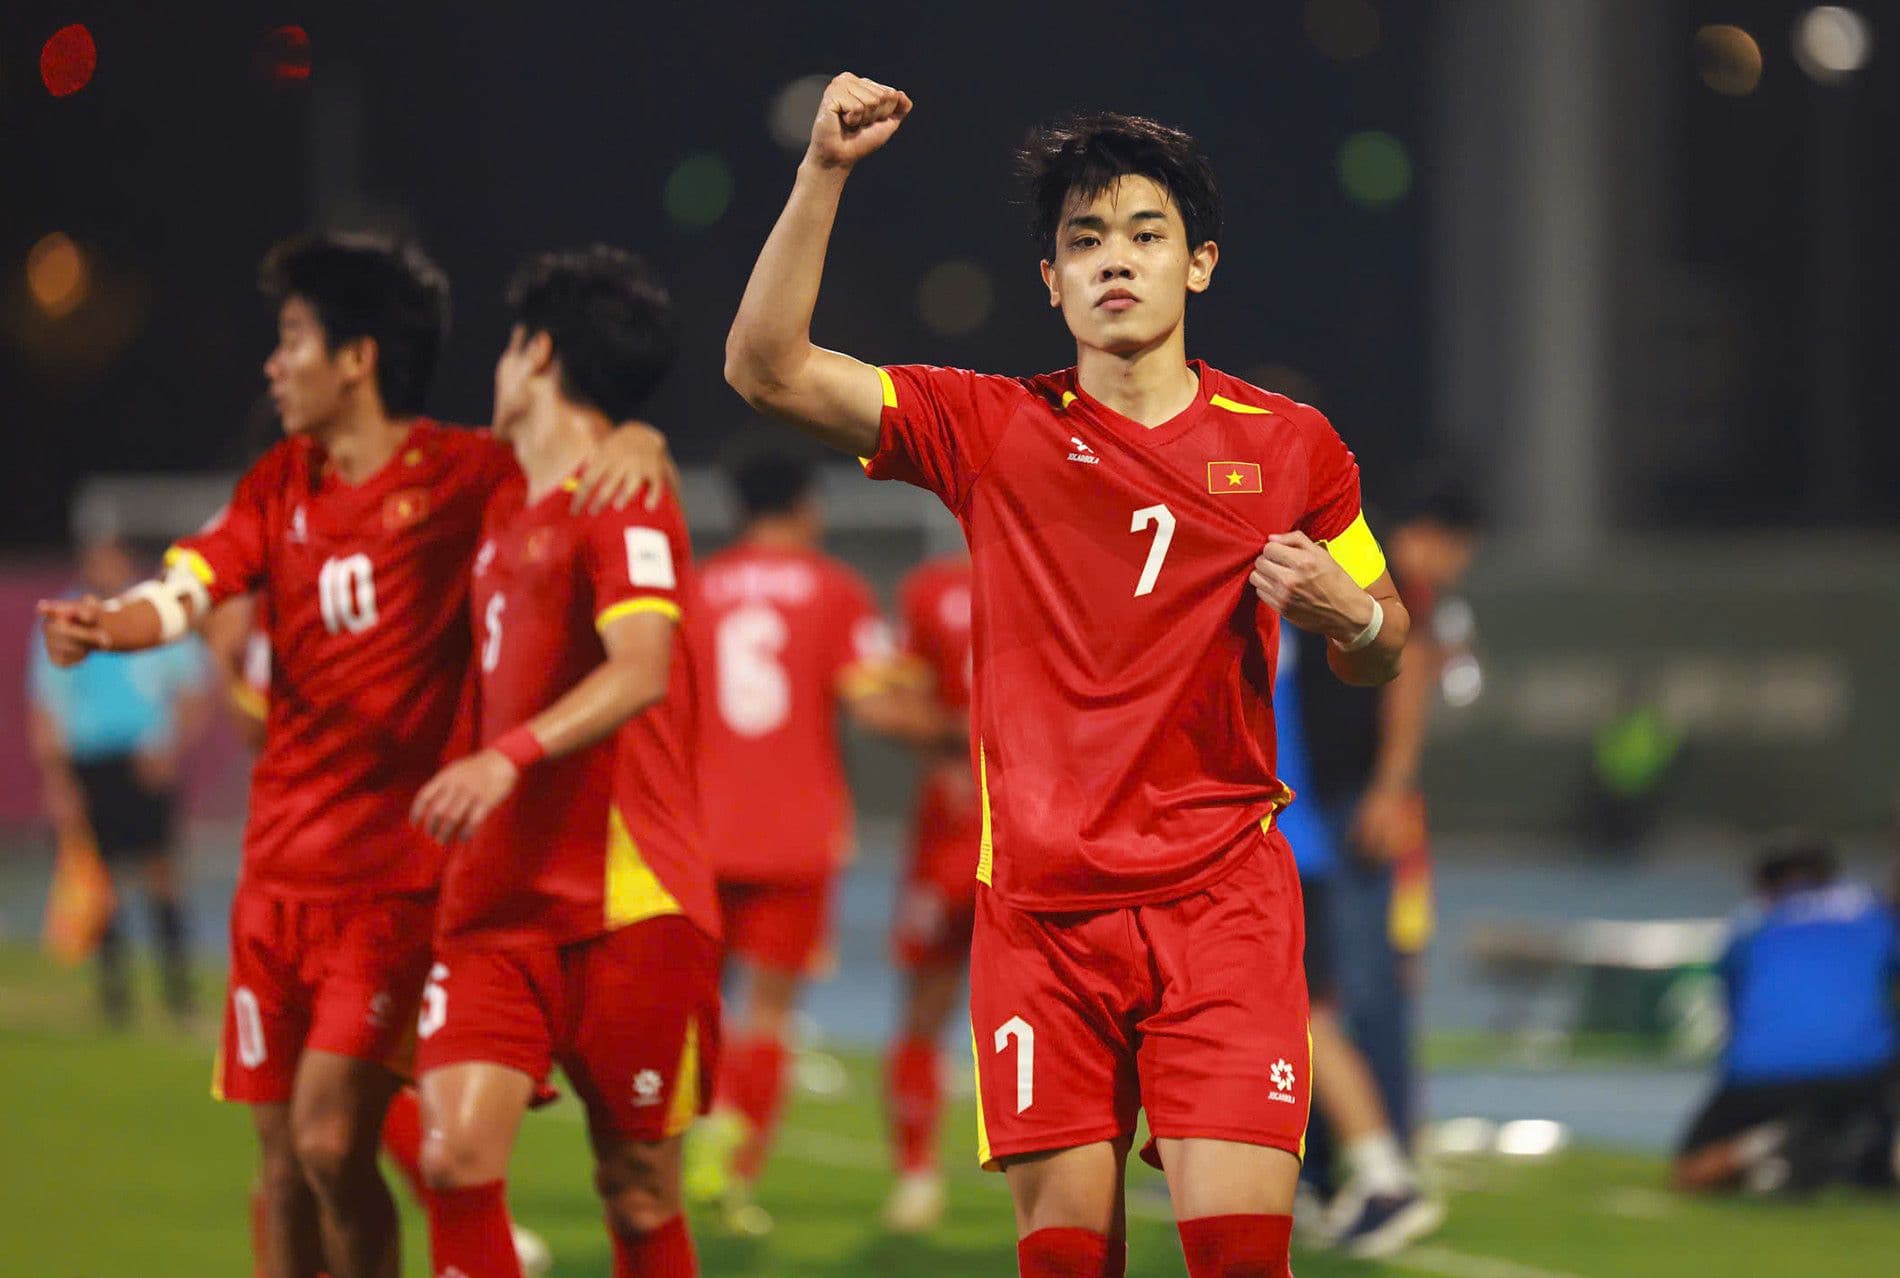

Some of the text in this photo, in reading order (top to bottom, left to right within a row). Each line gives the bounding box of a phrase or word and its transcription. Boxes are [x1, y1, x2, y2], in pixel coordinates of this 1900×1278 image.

[318, 553, 378, 634] 10
[1130, 504, 1176, 597] 7
[482, 591, 505, 672] 5
[716, 604, 791, 736] 6
[994, 1015, 1034, 1115] 7
